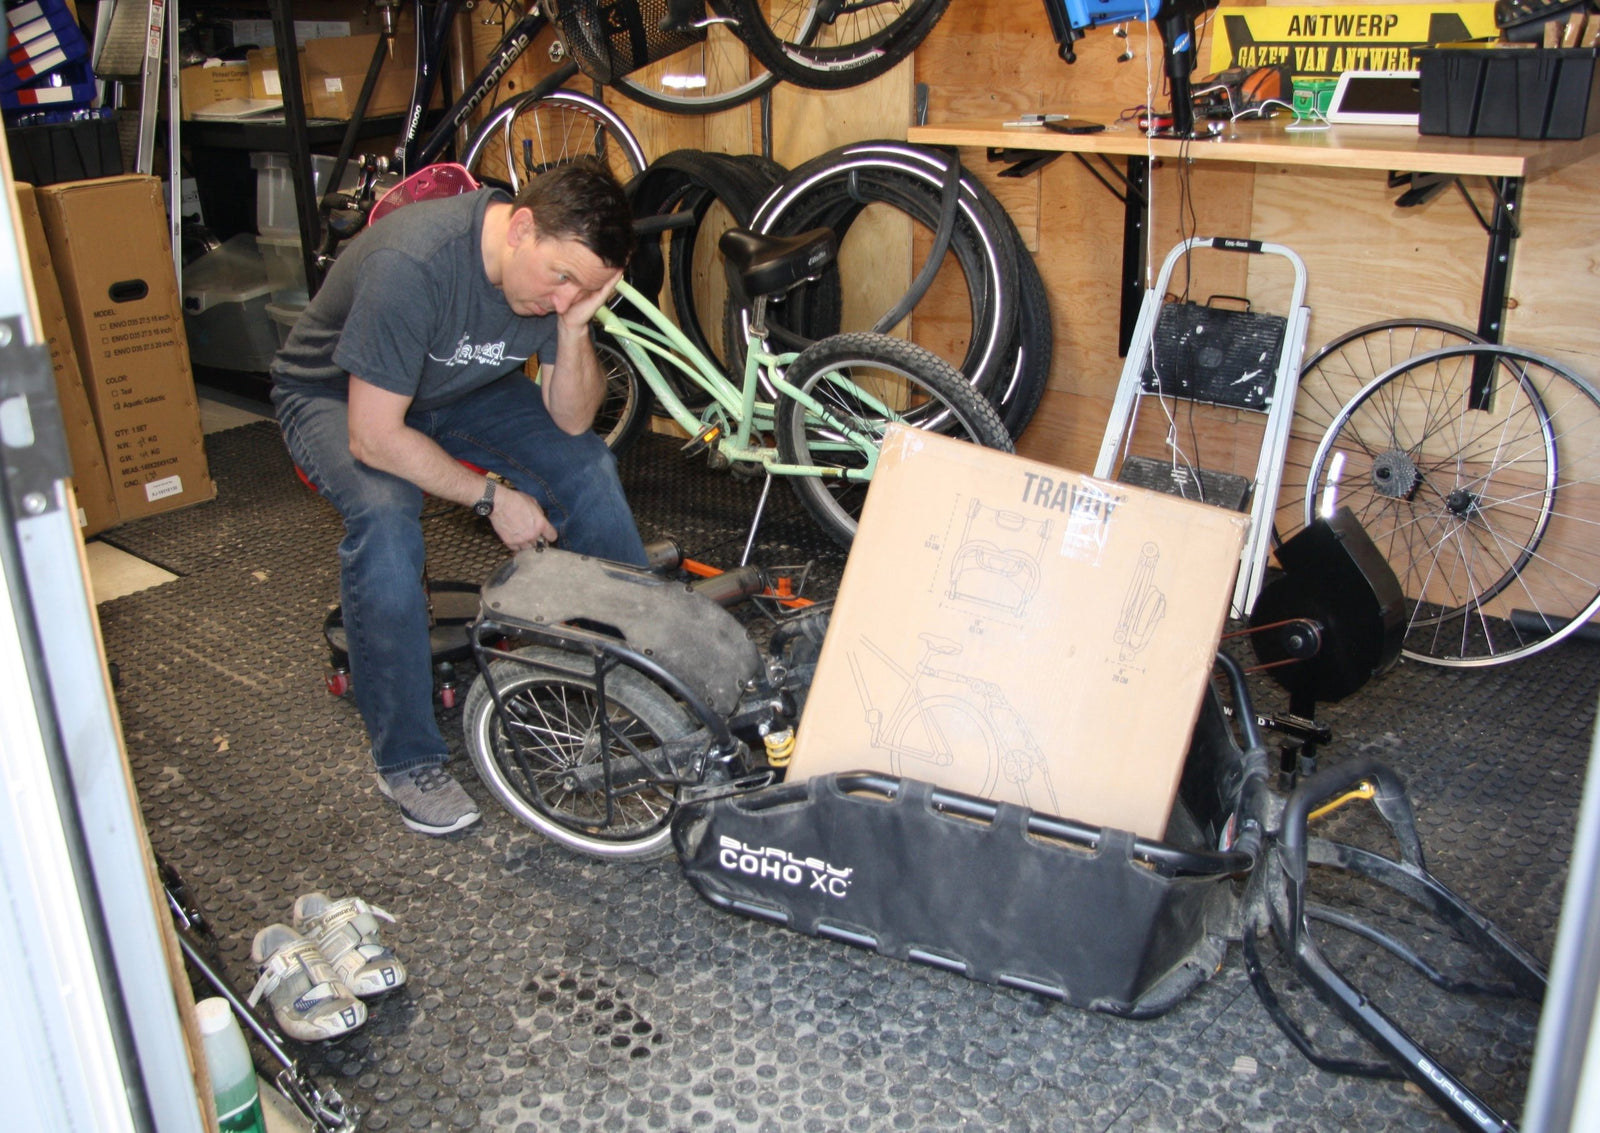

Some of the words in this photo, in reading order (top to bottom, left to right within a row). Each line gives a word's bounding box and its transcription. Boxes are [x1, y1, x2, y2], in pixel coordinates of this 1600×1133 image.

[1287, 14, 1398, 37] ANTWERP
[1238, 46, 1289, 68] GAZET
[1294, 47, 1329, 72] VAN
[454, 34, 530, 127] cannondale
[109, 320, 127, 330] ENVO
[111, 334, 129, 344] ENVO
[113, 347, 131, 356] ENVO
[720, 835, 849, 878] BURLEY
[720, 849, 802, 884] COHO
[810, 870, 847, 897] XC
[1418, 1059, 1491, 1125] BURLEY
